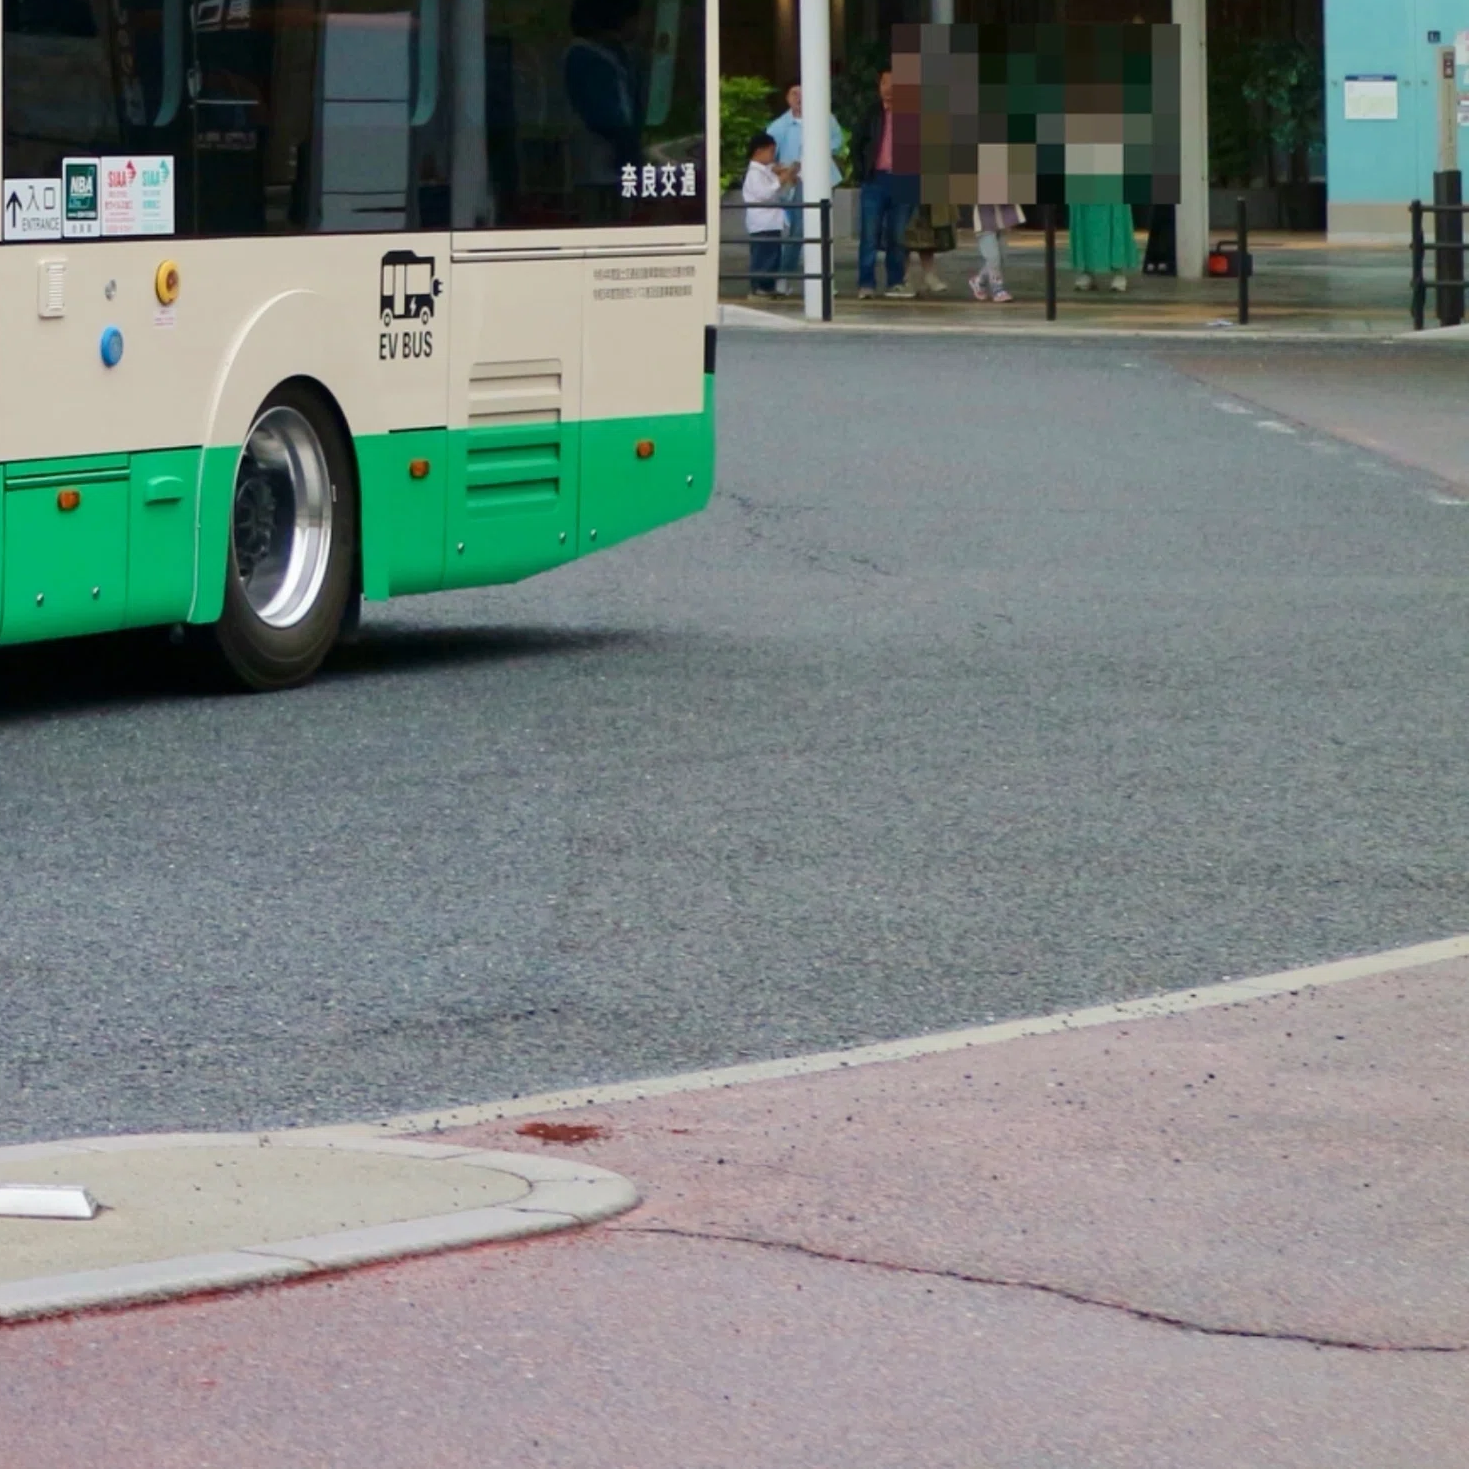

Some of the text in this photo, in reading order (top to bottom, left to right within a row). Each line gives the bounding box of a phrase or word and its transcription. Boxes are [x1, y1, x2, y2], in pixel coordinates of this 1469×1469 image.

[70, 175, 94, 194] NBA
[621, 162, 697, 198] 奈良交通
[26, 184, 56, 212] 入口
[22, 216, 61, 232] ENTRANCE
[379, 330, 433, 360] EV BUS
